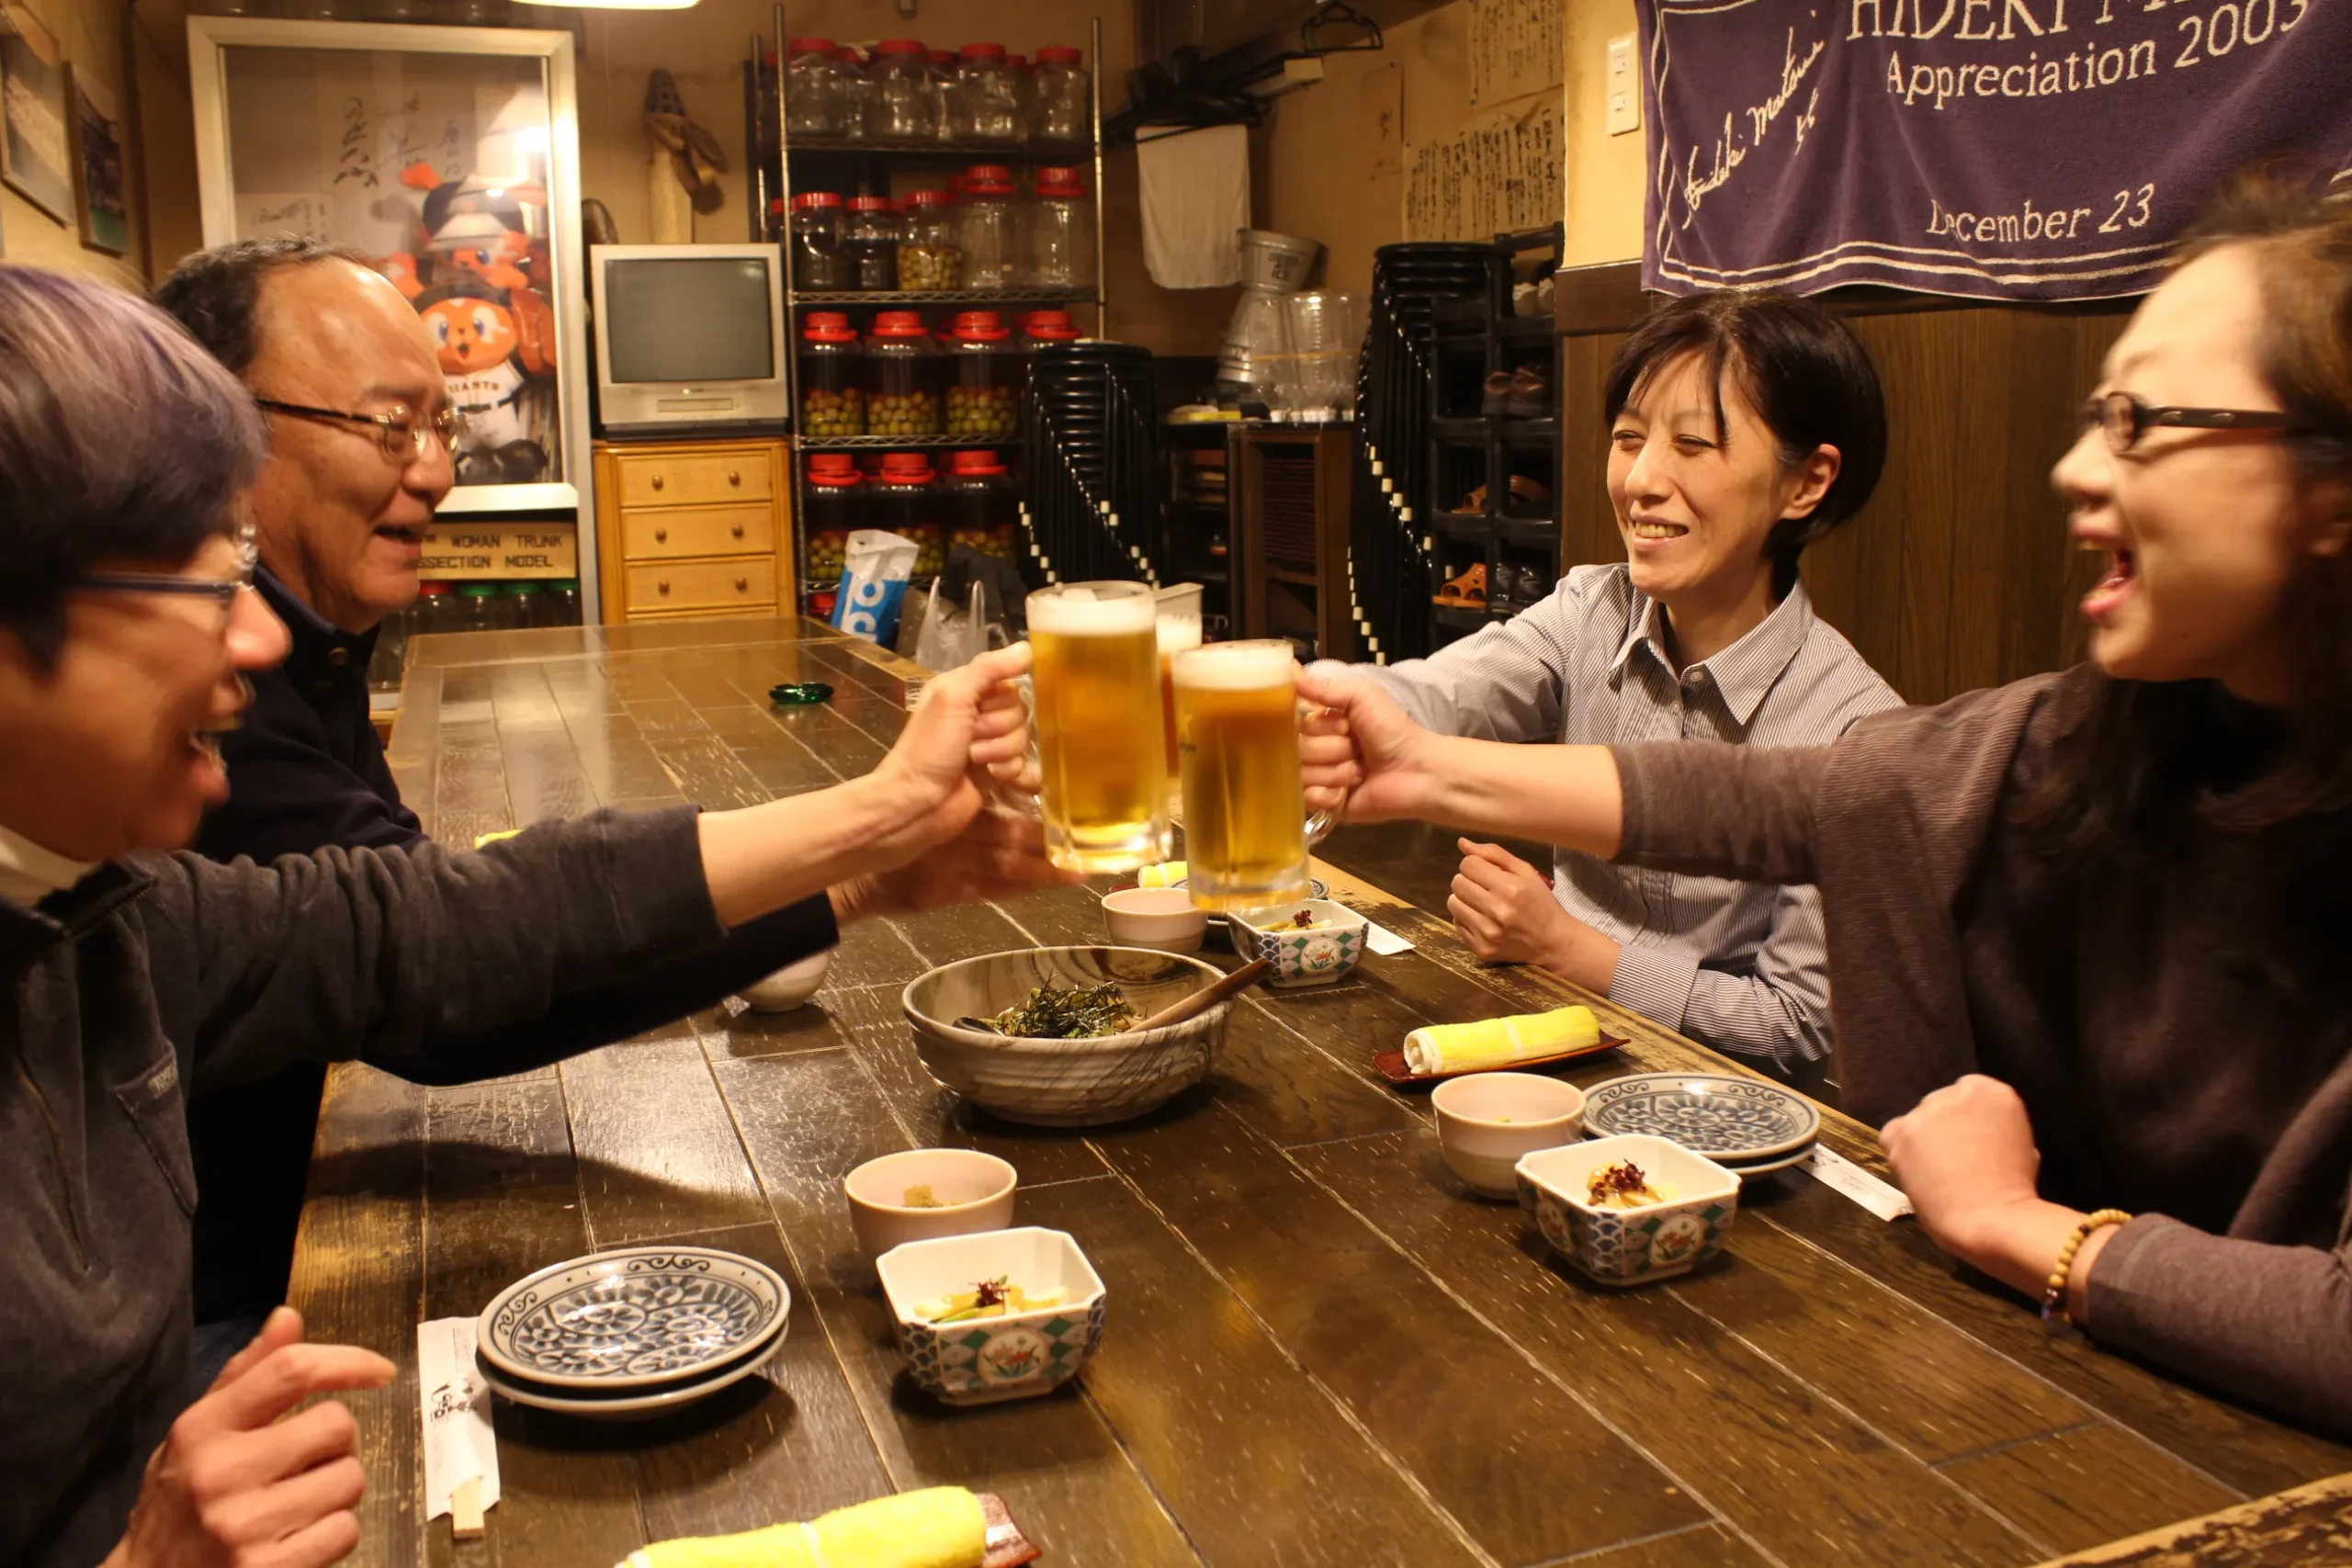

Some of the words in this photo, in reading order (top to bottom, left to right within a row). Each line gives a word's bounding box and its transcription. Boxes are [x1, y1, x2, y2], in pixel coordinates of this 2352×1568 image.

[1886, 39, 2157, 110] Appreciation
[2098, 183, 2155, 233] 23
[451, 535, 501, 548] WOMAN
[515, 534, 562, 547] TRUNK
[416, 556, 492, 569] SSECTION
[505, 554, 554, 568] MODEL
